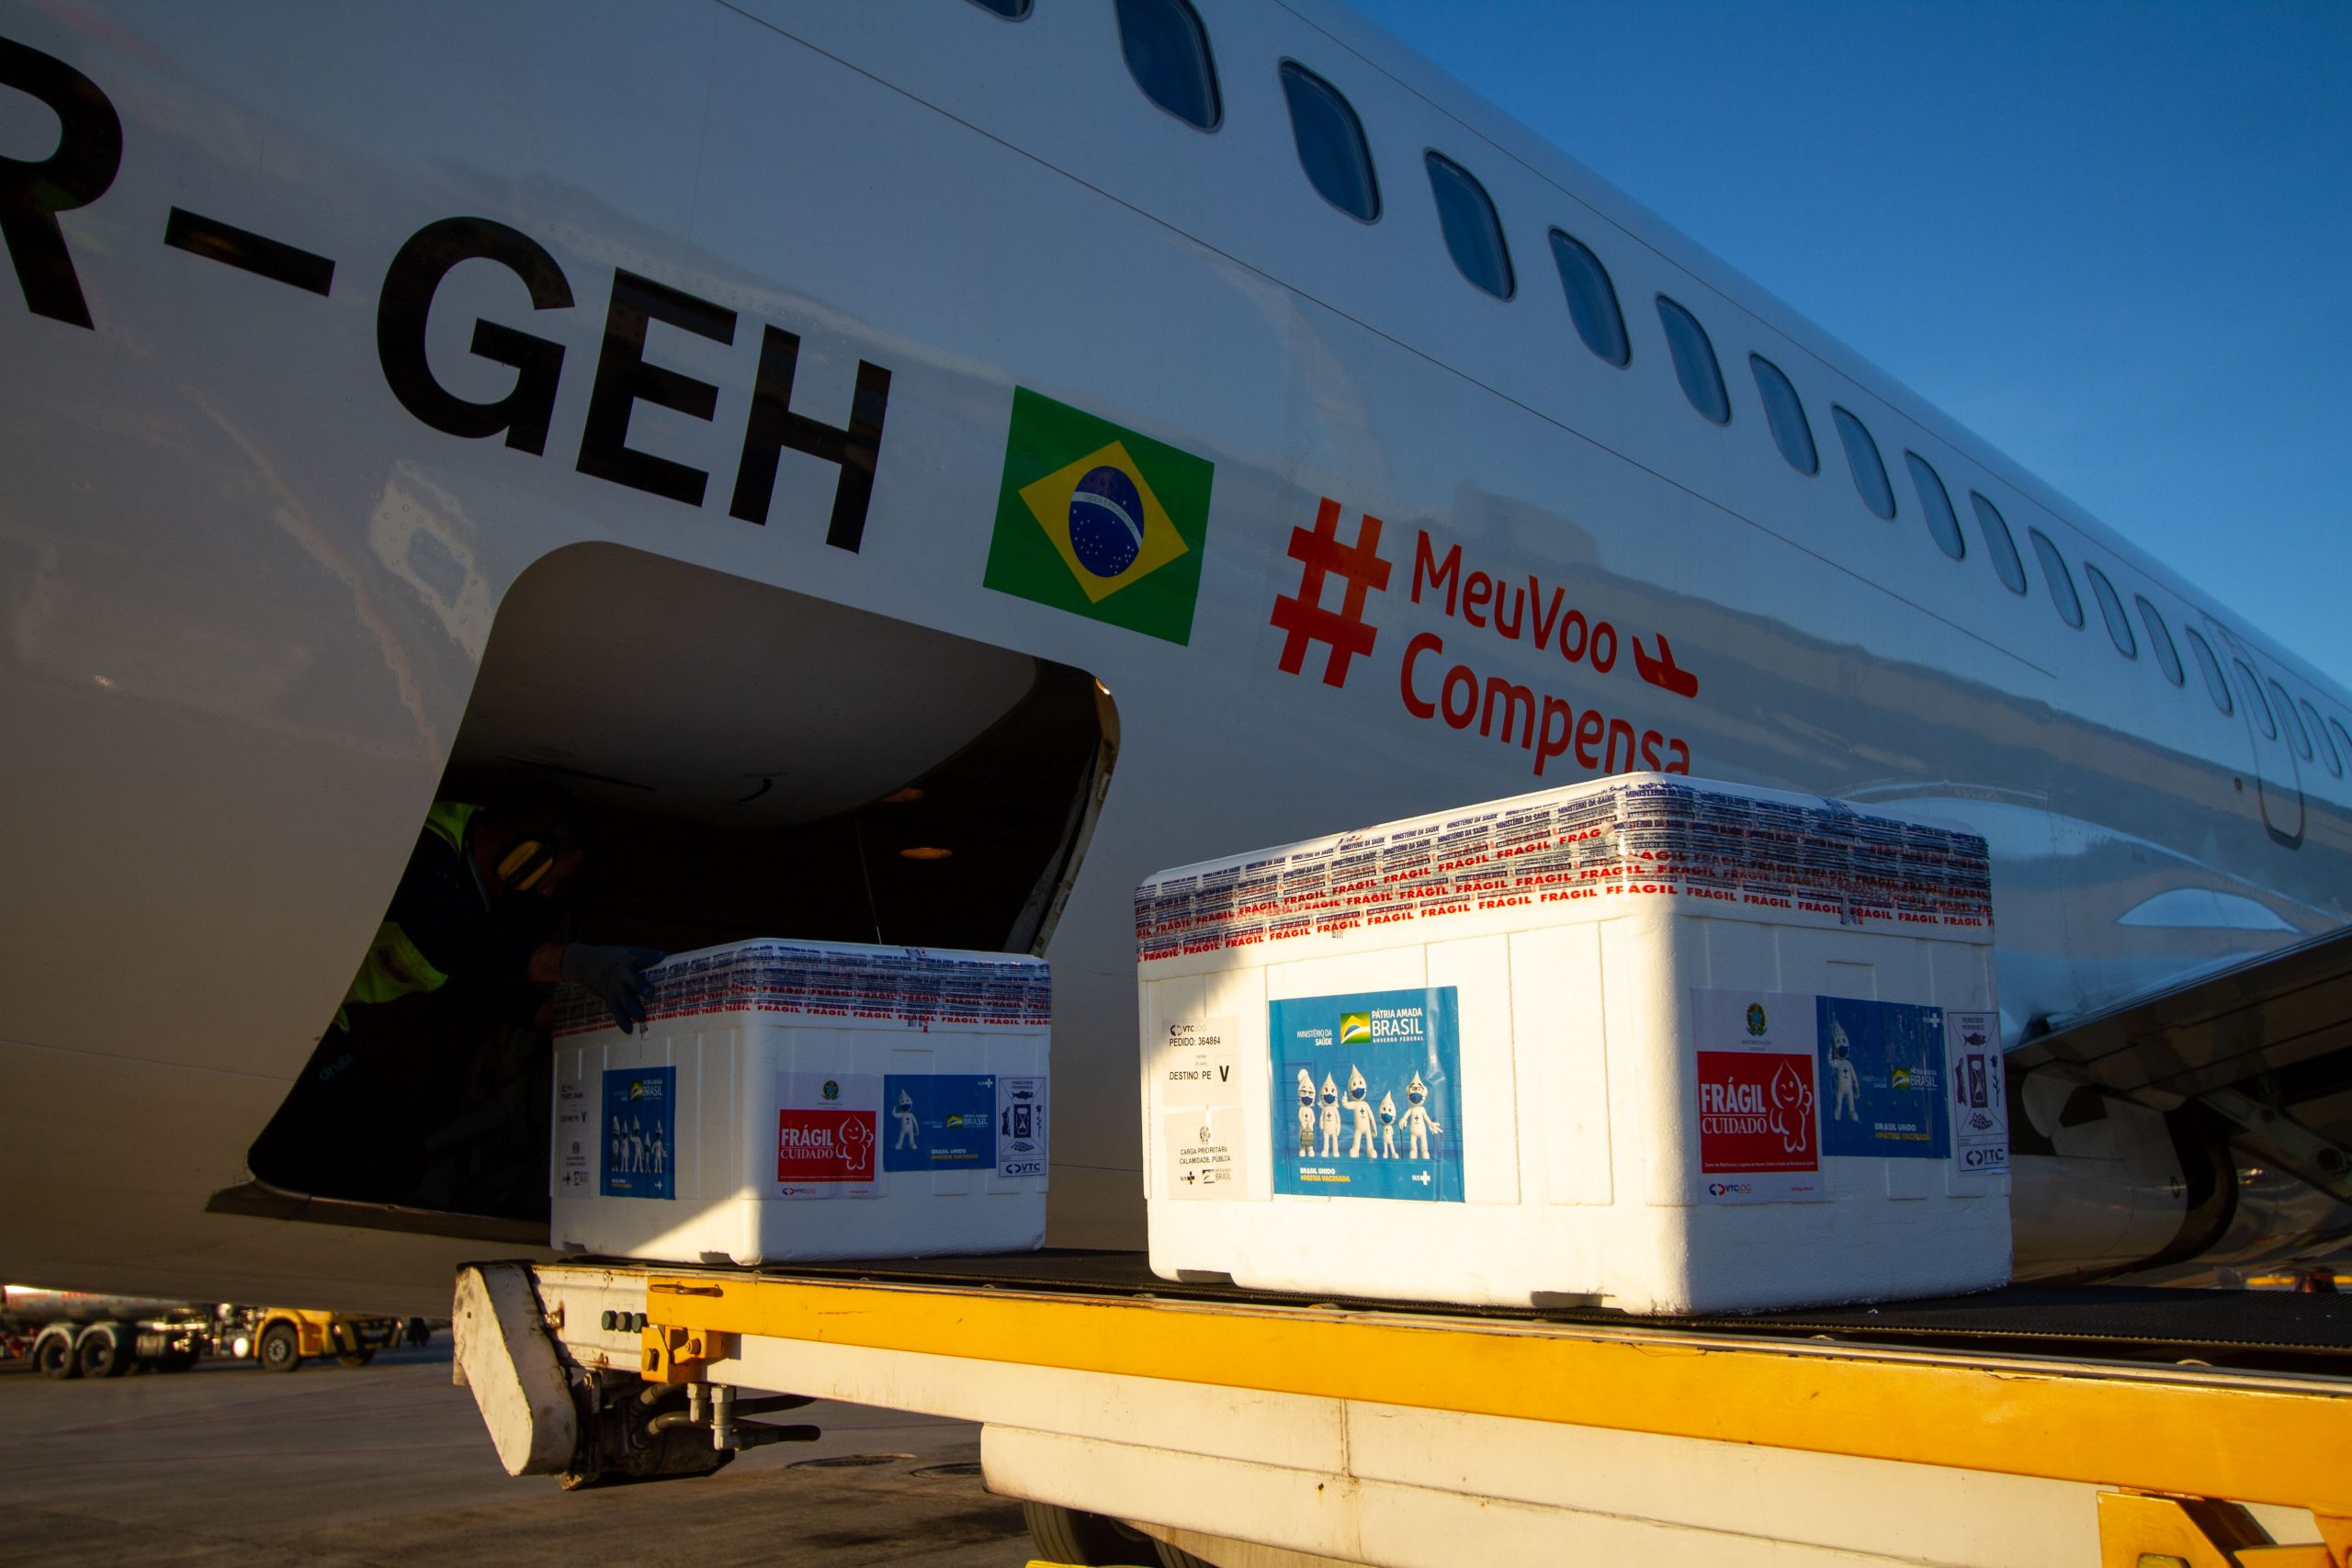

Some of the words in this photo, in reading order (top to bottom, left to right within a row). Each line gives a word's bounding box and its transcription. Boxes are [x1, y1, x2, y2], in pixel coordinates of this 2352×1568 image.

[1400, 631, 1690, 776] Compensa
[1439, 854, 1488, 873] FRÁGIL
[1497, 840, 1550, 860] FRÁGIL
[1456, 879, 1508, 894] FRÁGIL
[1516, 871, 1571, 886] FRÁGIL
[1687, 886, 1736, 901] FRÁGIL
[1744, 893, 1792, 908] FRÁGIL
[1798, 901, 1843, 914] FRÁGIL
[1849, 907, 1893, 919] FRÁGIL
[1898, 912, 1939, 923] FRÁGIL
[1944, 917, 1982, 926] FRÁGIL
[1226, 934, 1263, 948] FRÁGIL
[1270, 928, 1310, 941] FRÁGIL
[1317, 919, 1361, 932] FRÁGIL
[1367, 911, 1414, 925] FRÁGIL
[1420, 904, 1470, 917] FRÁGIL
[1479, 896, 1532, 909] FRÁGIL
[1541, 889, 1597, 902] FRÁGIL
[758, 1005, 800, 1013] FRÁGIL
[807, 1007, 847, 1016] FRÁGIL
[854, 1010, 892, 1019] FRÁGIL
[941, 1016, 978, 1024] FRÁGIL
[1372, 1009, 1395, 1020] PÁTRIA
[1396, 1008, 1422, 1018] AMADA
[1297, 1029, 1325, 1038] MINISTÉRIO
[1373, 1019, 1424, 1036] BRASIL
[1315, 1036, 1332, 1045] SAÚDE
[1202, 1071, 1211, 1079] PE
[1219, 1066, 1229, 1082] V
[1911, 1075, 1938, 1088] BRASIL
[1701, 1076, 1767, 1113] FRÁGIL
[1702, 1117, 1768, 1134] CUIDADO
[1874, 1122, 1896, 1131] BRASIL
[1898, 1123, 1917, 1132] UNIDO
[781, 1124, 834, 1146] FRÁGIL
[780, 1148, 834, 1159] CUIDADO
[1984, 1148, 2004, 1161] VTC
